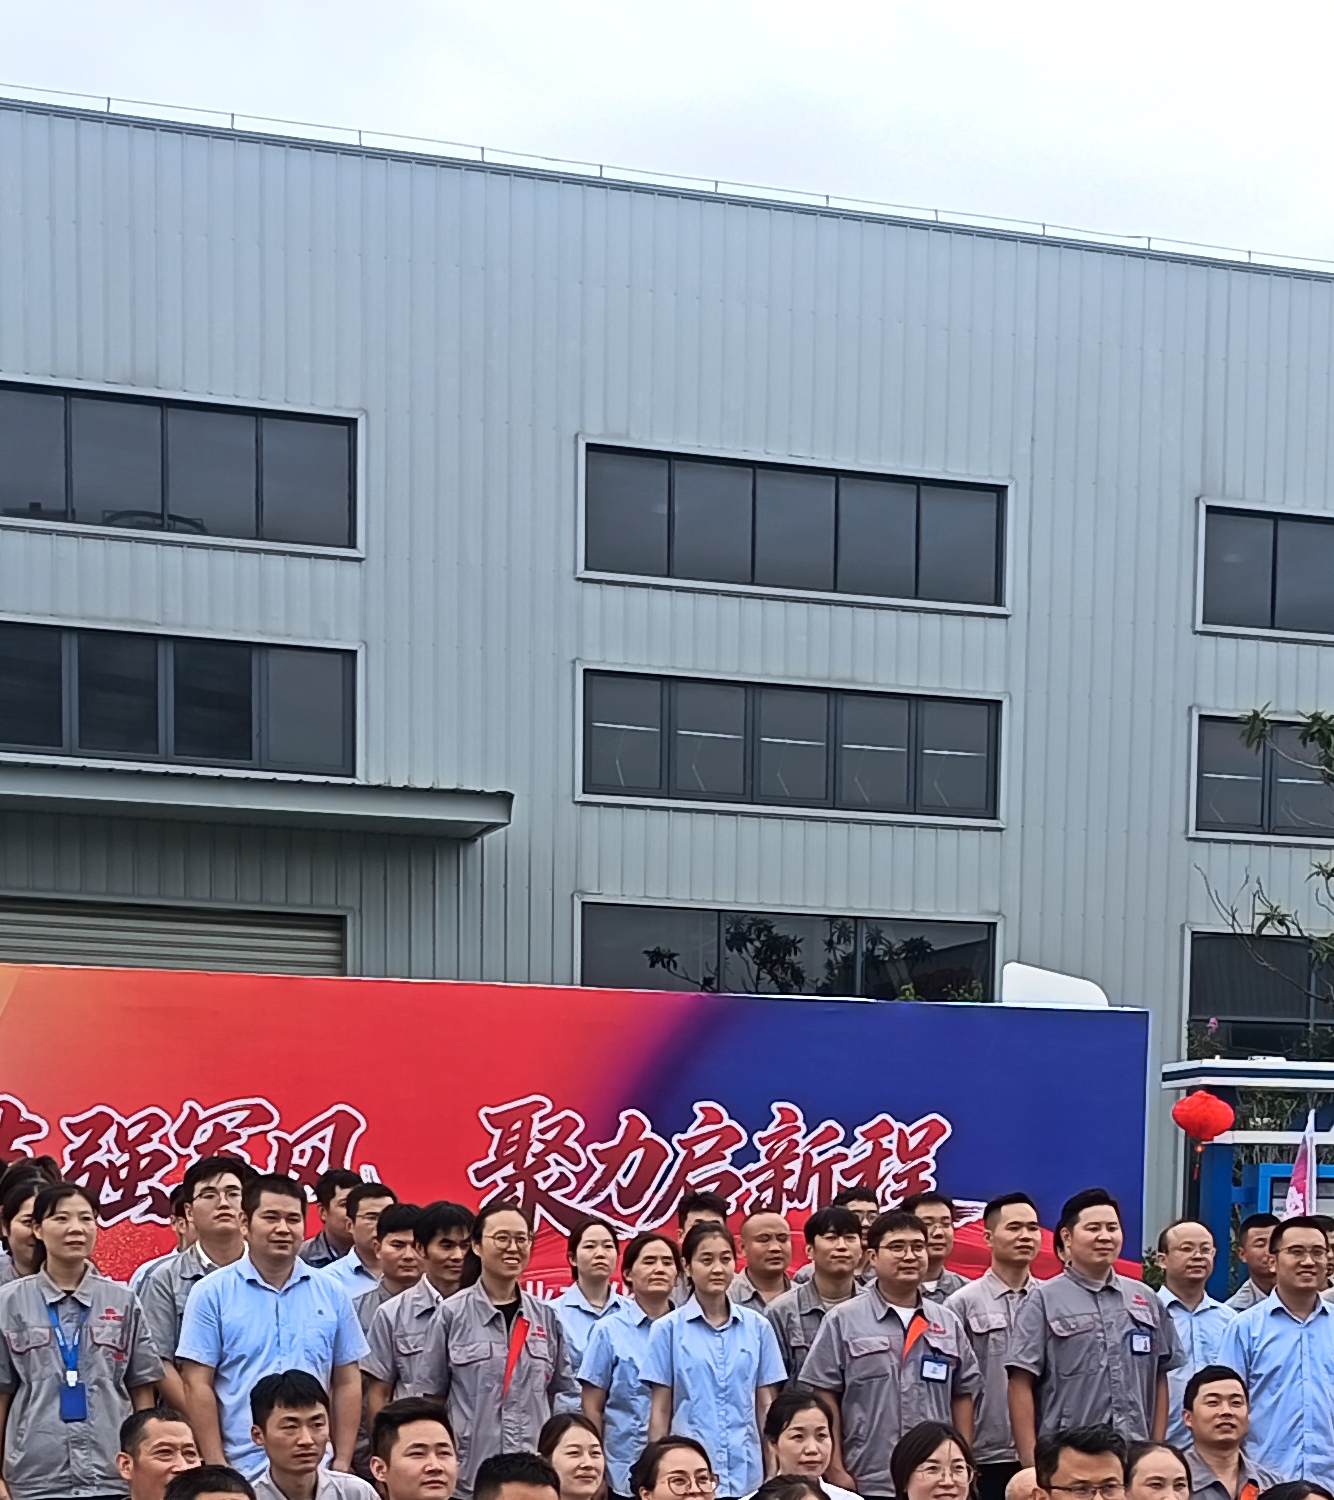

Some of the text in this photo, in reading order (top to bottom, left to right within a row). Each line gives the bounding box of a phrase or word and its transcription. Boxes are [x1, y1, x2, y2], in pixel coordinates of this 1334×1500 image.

[468, 1094, 987, 1240] 聚力启新程
